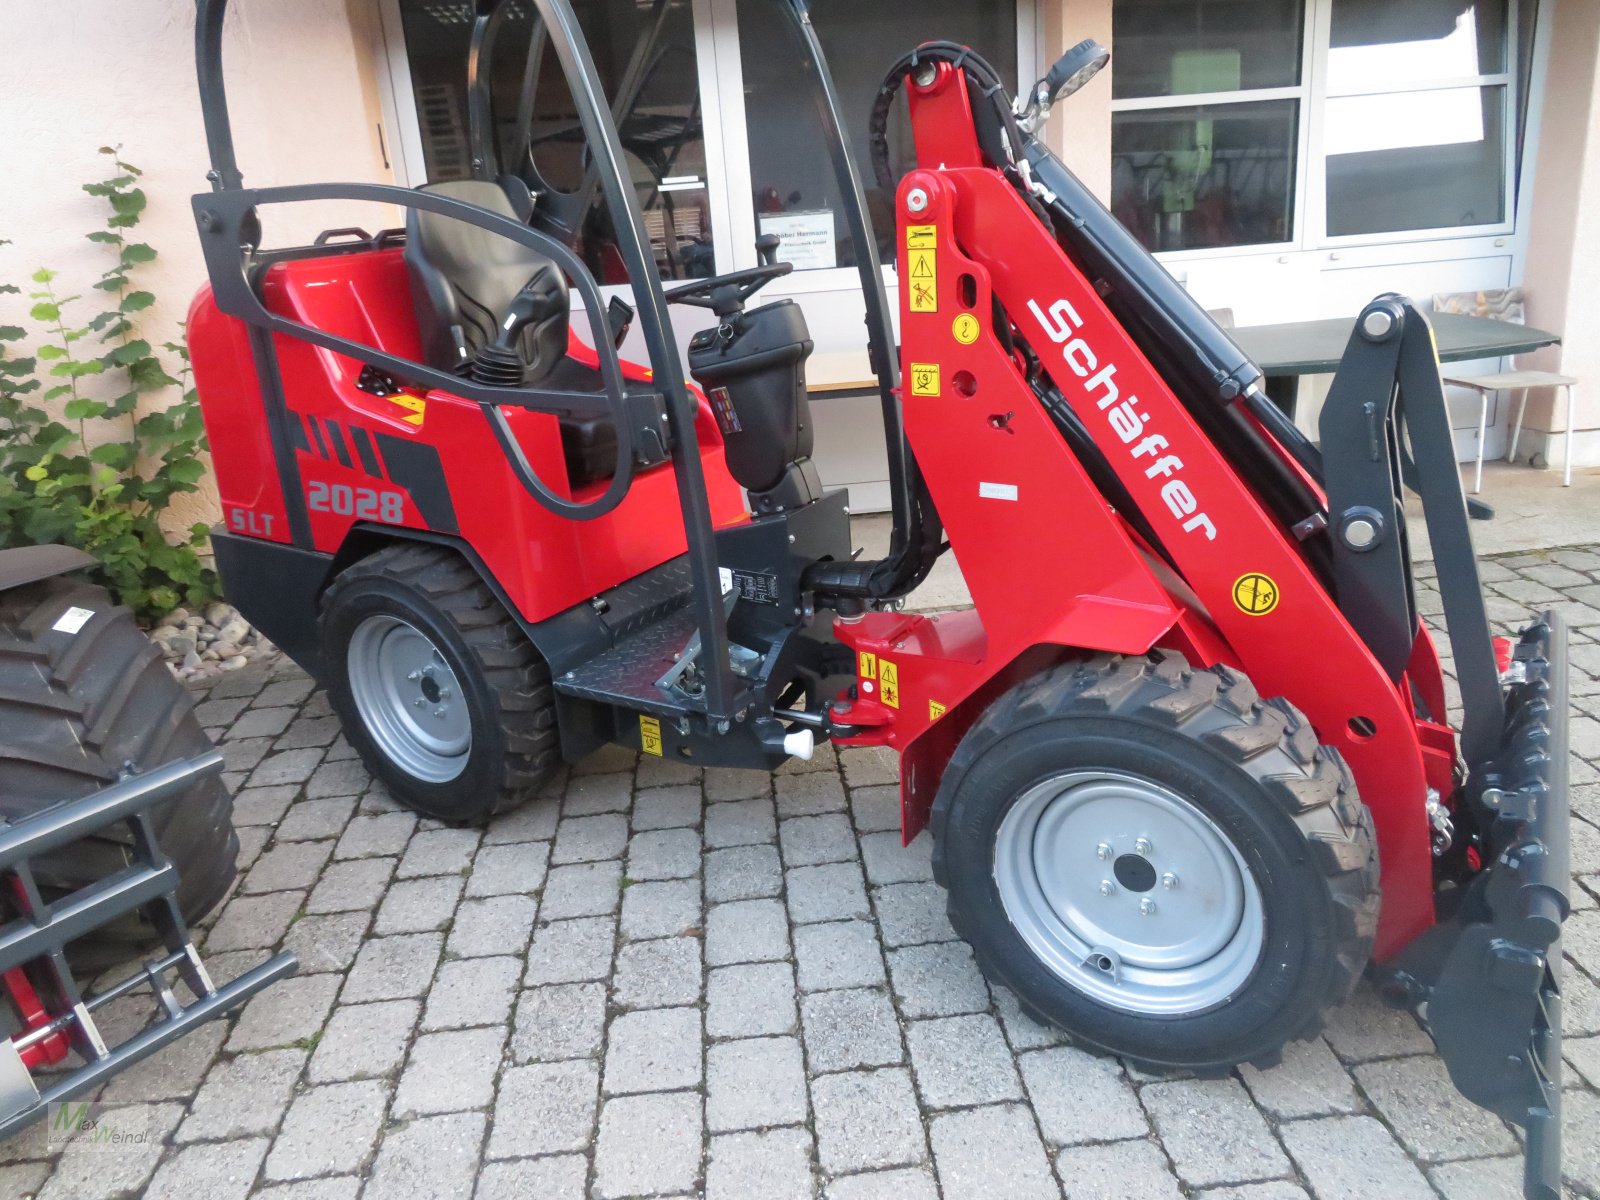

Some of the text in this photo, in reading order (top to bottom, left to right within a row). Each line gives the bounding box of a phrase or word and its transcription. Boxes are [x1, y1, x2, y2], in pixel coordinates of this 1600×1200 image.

[1027, 299, 1217, 541] Schäffer
[231, 508, 274, 536] SLT
[308, 480, 404, 524] 2028
